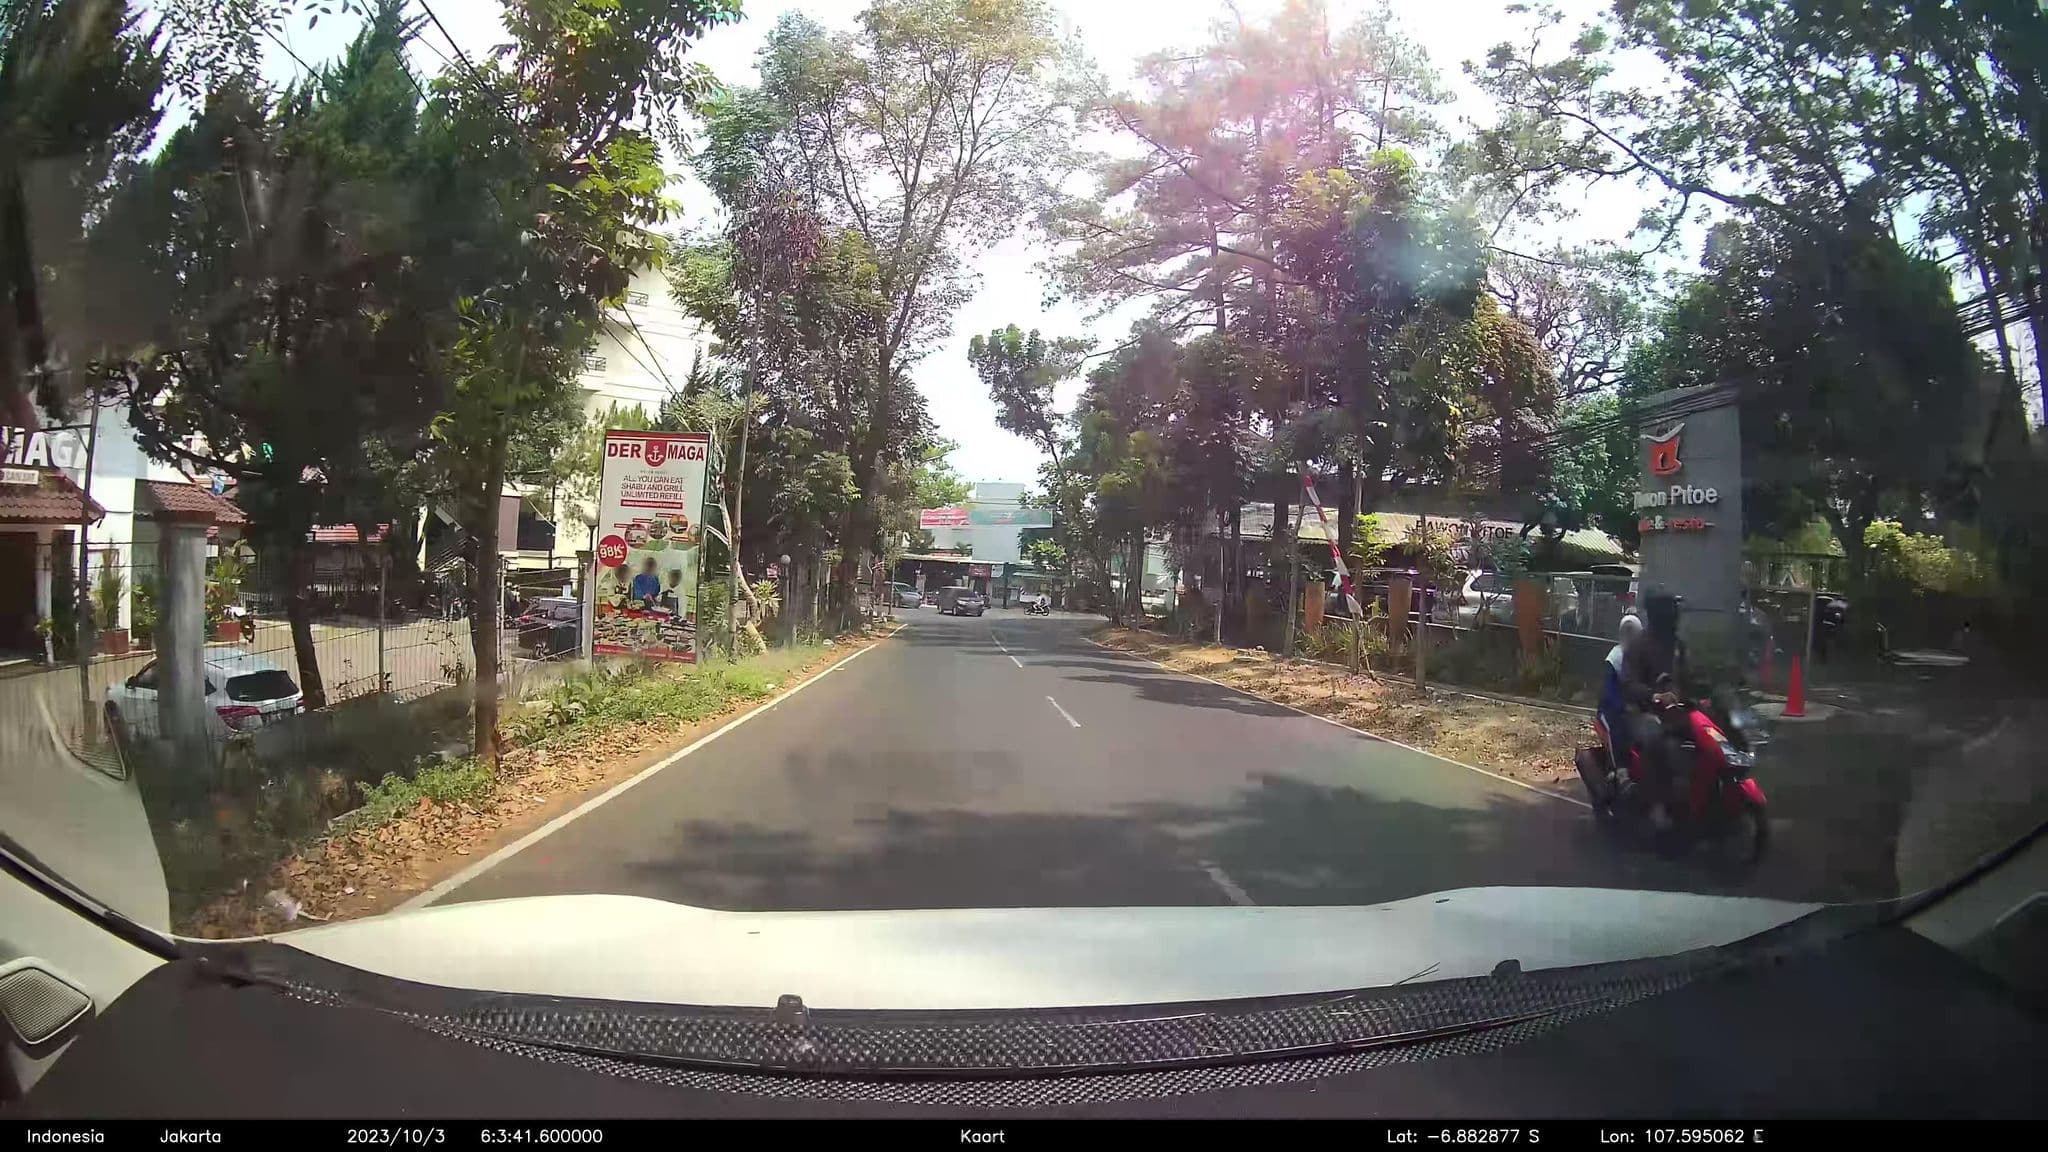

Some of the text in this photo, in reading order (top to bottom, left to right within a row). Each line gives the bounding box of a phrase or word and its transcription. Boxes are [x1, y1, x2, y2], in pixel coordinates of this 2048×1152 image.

[607, 443, 705, 462] DER MAGA
[637, 475, 653, 483] YOU
[621, 482, 684, 492] SHABU AND GRILL
[621, 490, 683, 500] UNLIMITED REFILL
[1670, 484, 1718, 505] Pitoe
[600, 544, 623, 559] 98K
